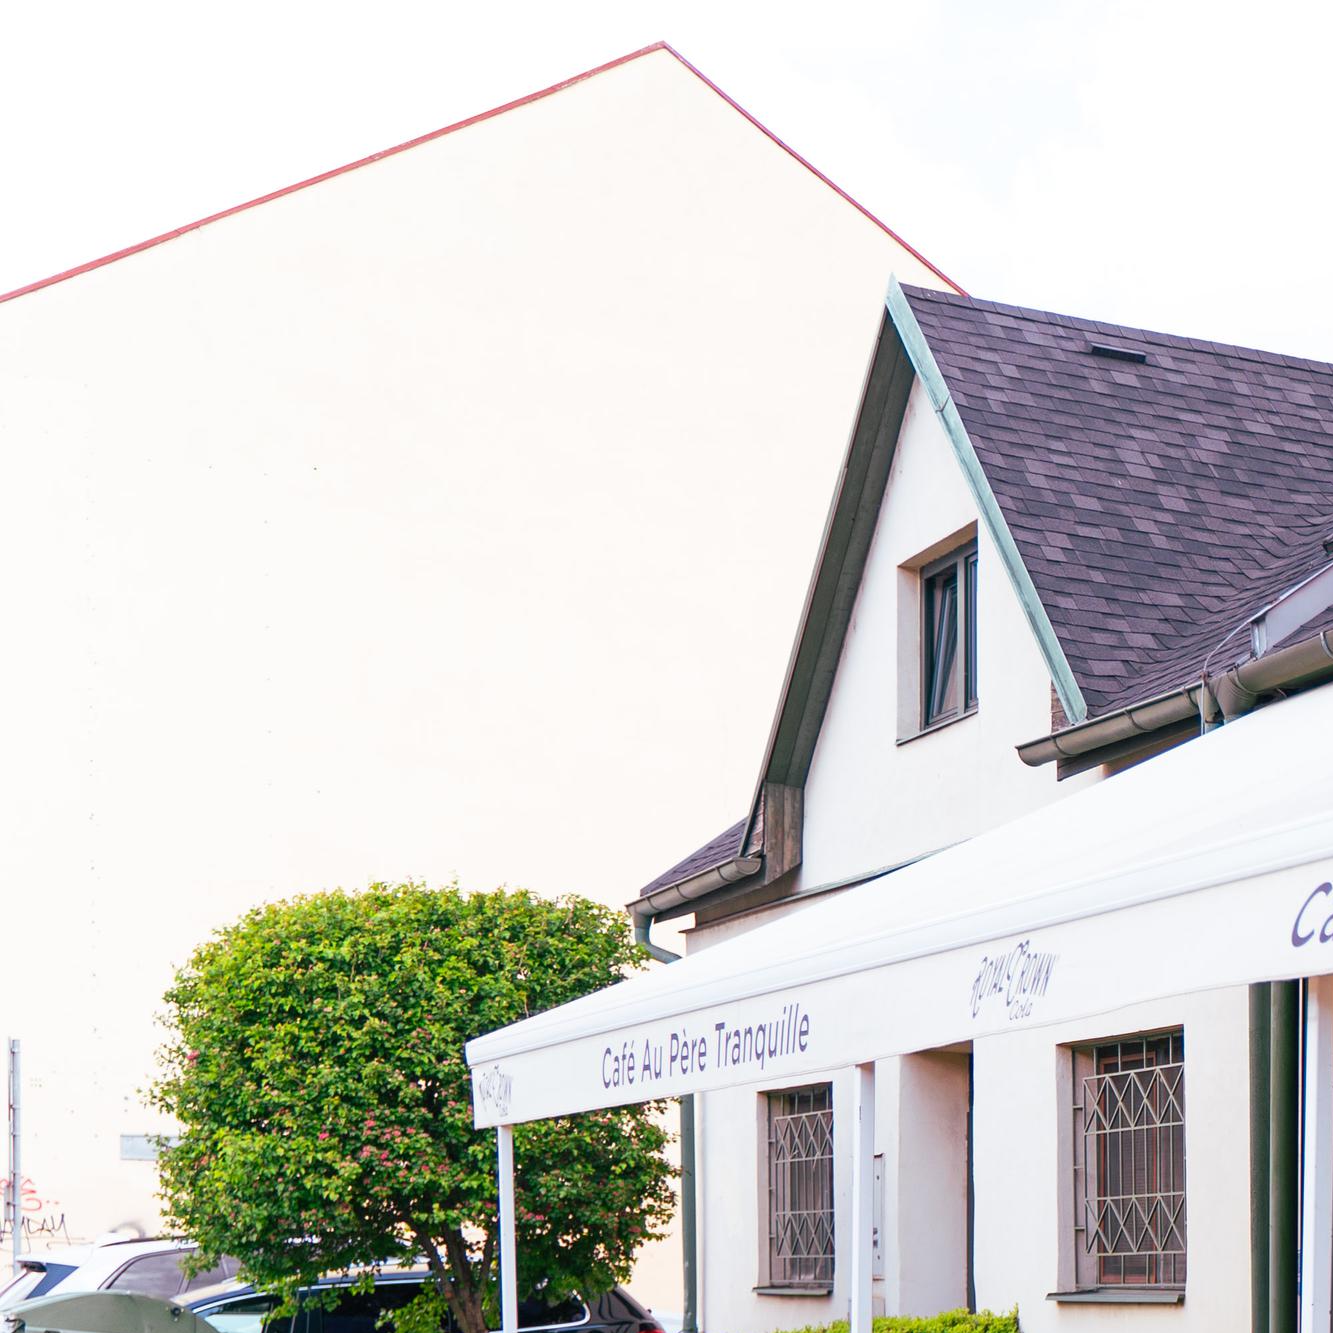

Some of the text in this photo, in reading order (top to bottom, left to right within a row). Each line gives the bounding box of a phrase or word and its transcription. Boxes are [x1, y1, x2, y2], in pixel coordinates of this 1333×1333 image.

[602, 1002, 810, 1089] Café Au Père Tranquille
